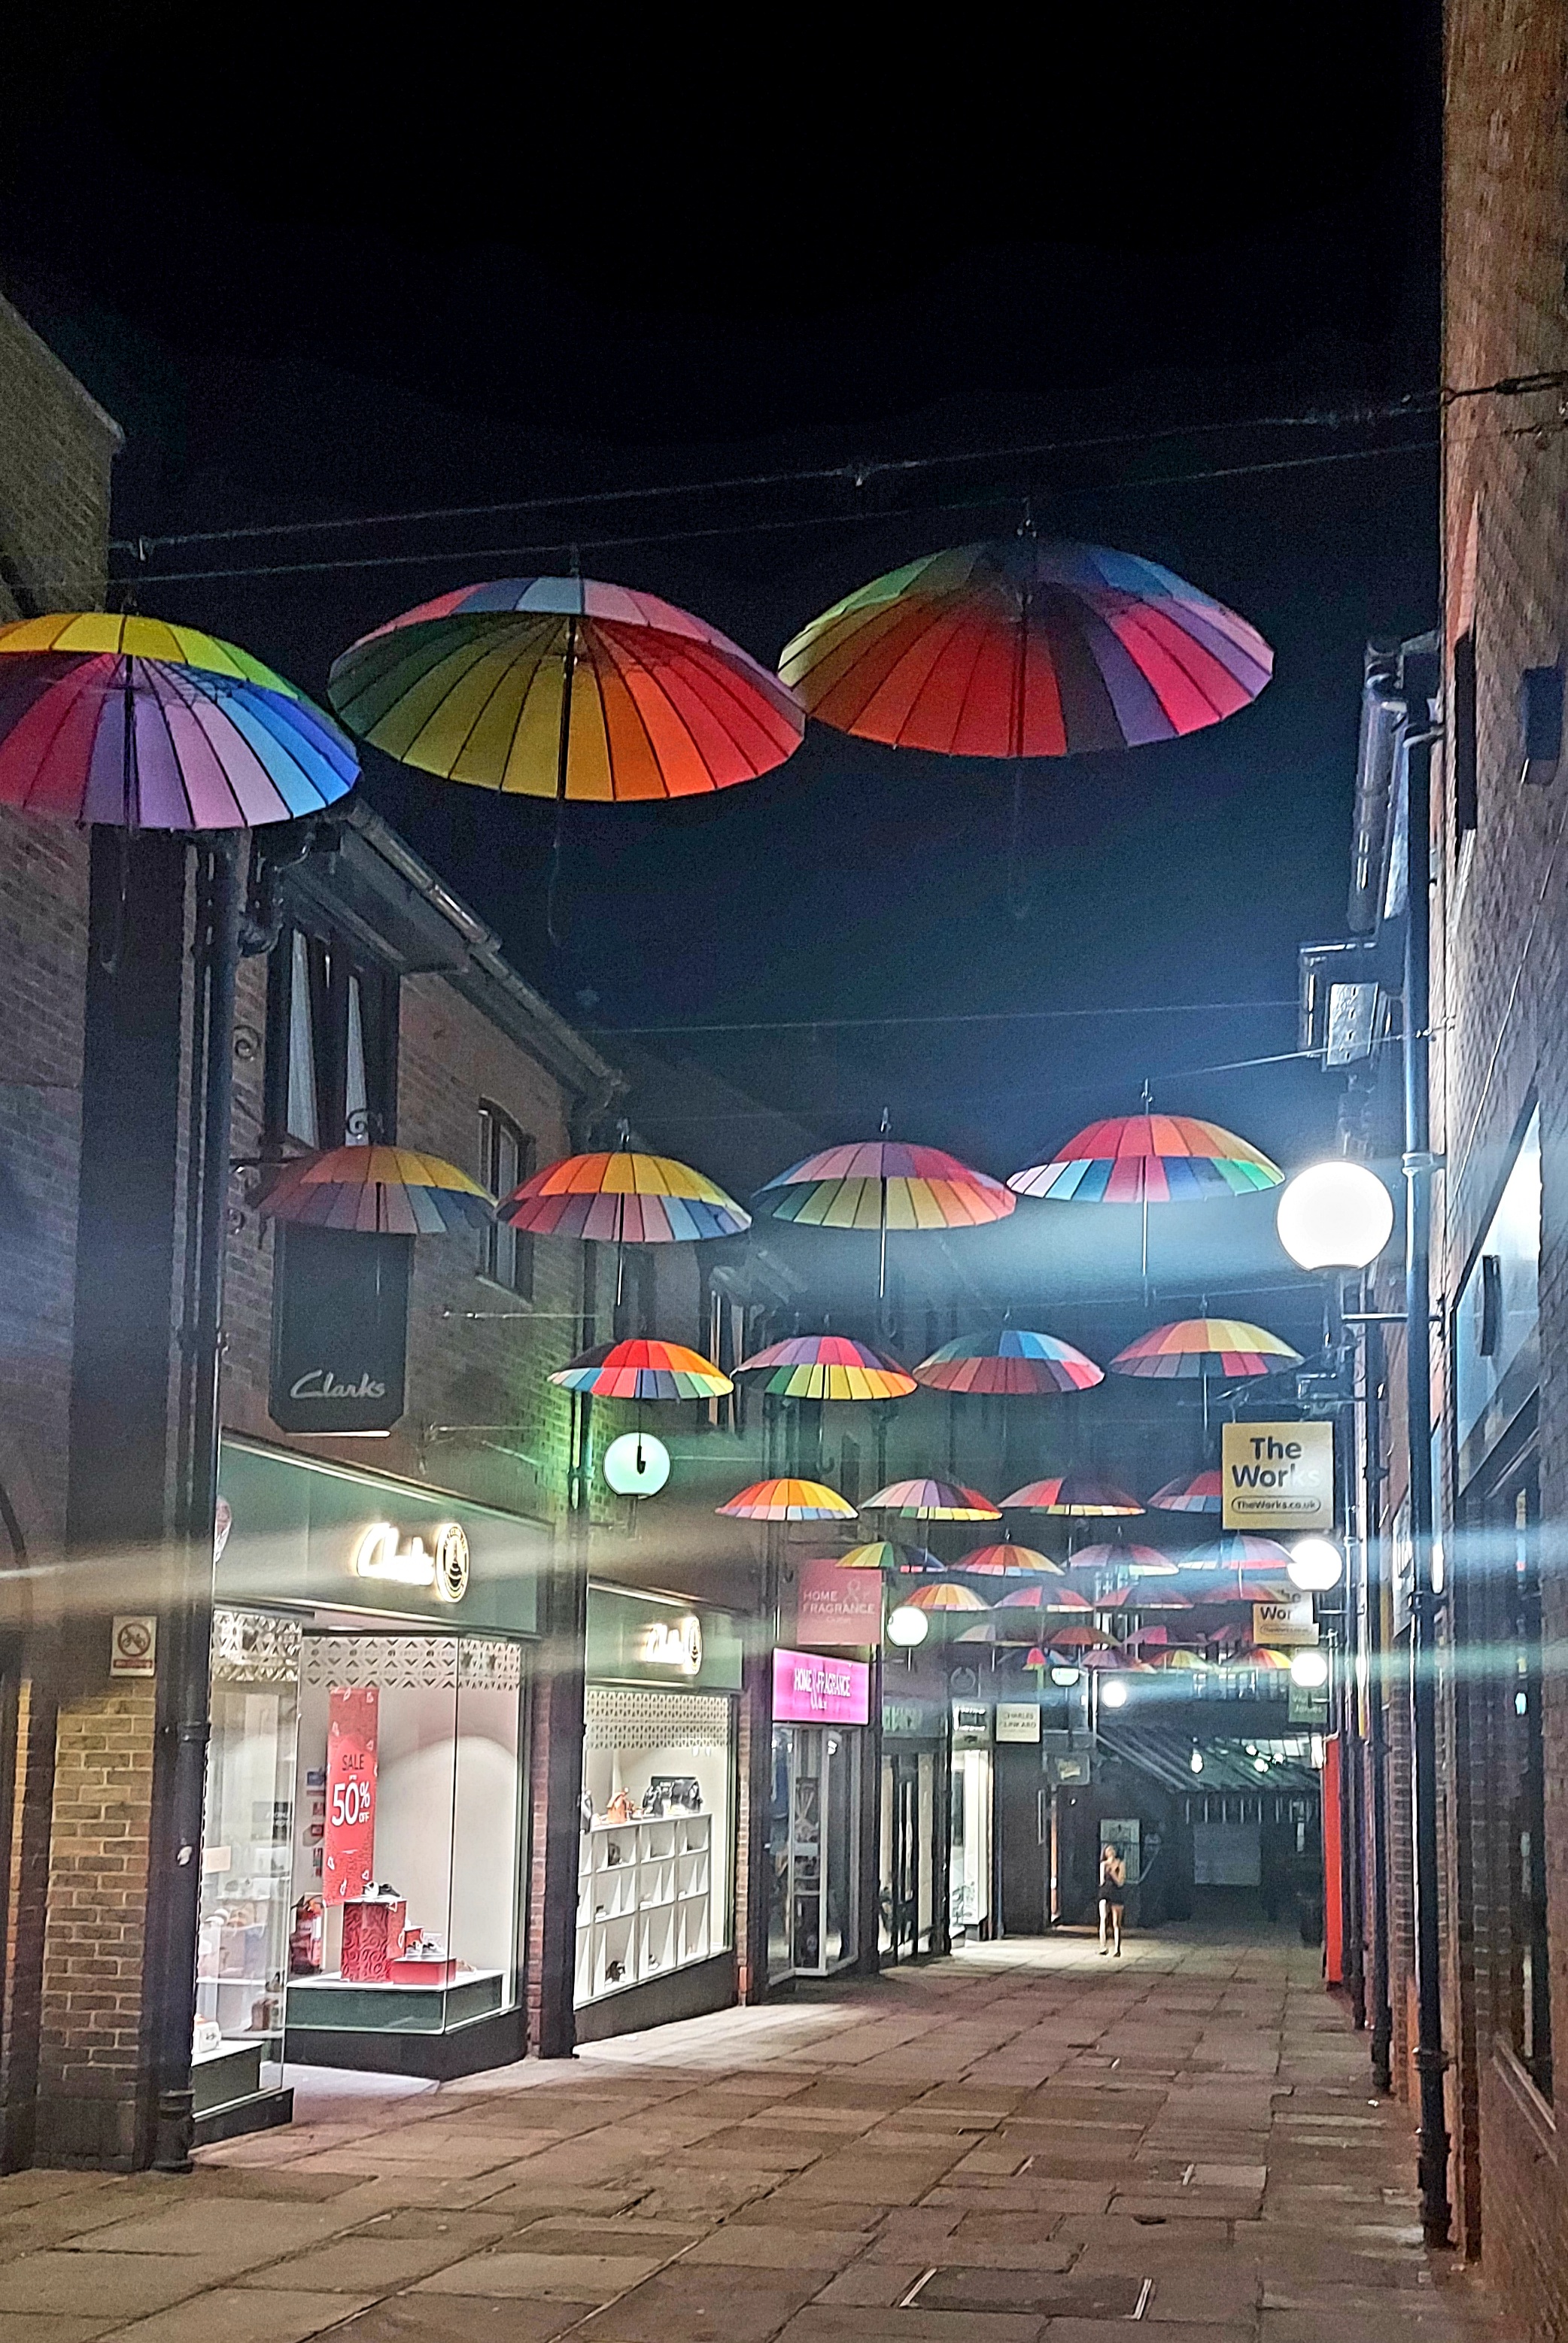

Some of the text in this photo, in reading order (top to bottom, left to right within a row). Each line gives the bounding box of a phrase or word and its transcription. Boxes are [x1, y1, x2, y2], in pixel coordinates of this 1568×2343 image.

[290, 1369, 385, 1398] Clarks
[1250, 1436, 1302, 1460] The
[1237, 1500, 1316, 1509] TheWorks.co.uk
[357, 1522, 434, 1586] Clks
[804, 1591, 838, 1602] HOME
[803, 1603, 875, 1615] FRAGRANCE
[795, 1667, 812, 1693] HOME
[817, 1670, 851, 1697] FRAGRANCE
[342, 1754, 365, 1770] SALE
[331, 1781, 371, 1827] 50%
[358, 1811, 370, 1823] OFF
